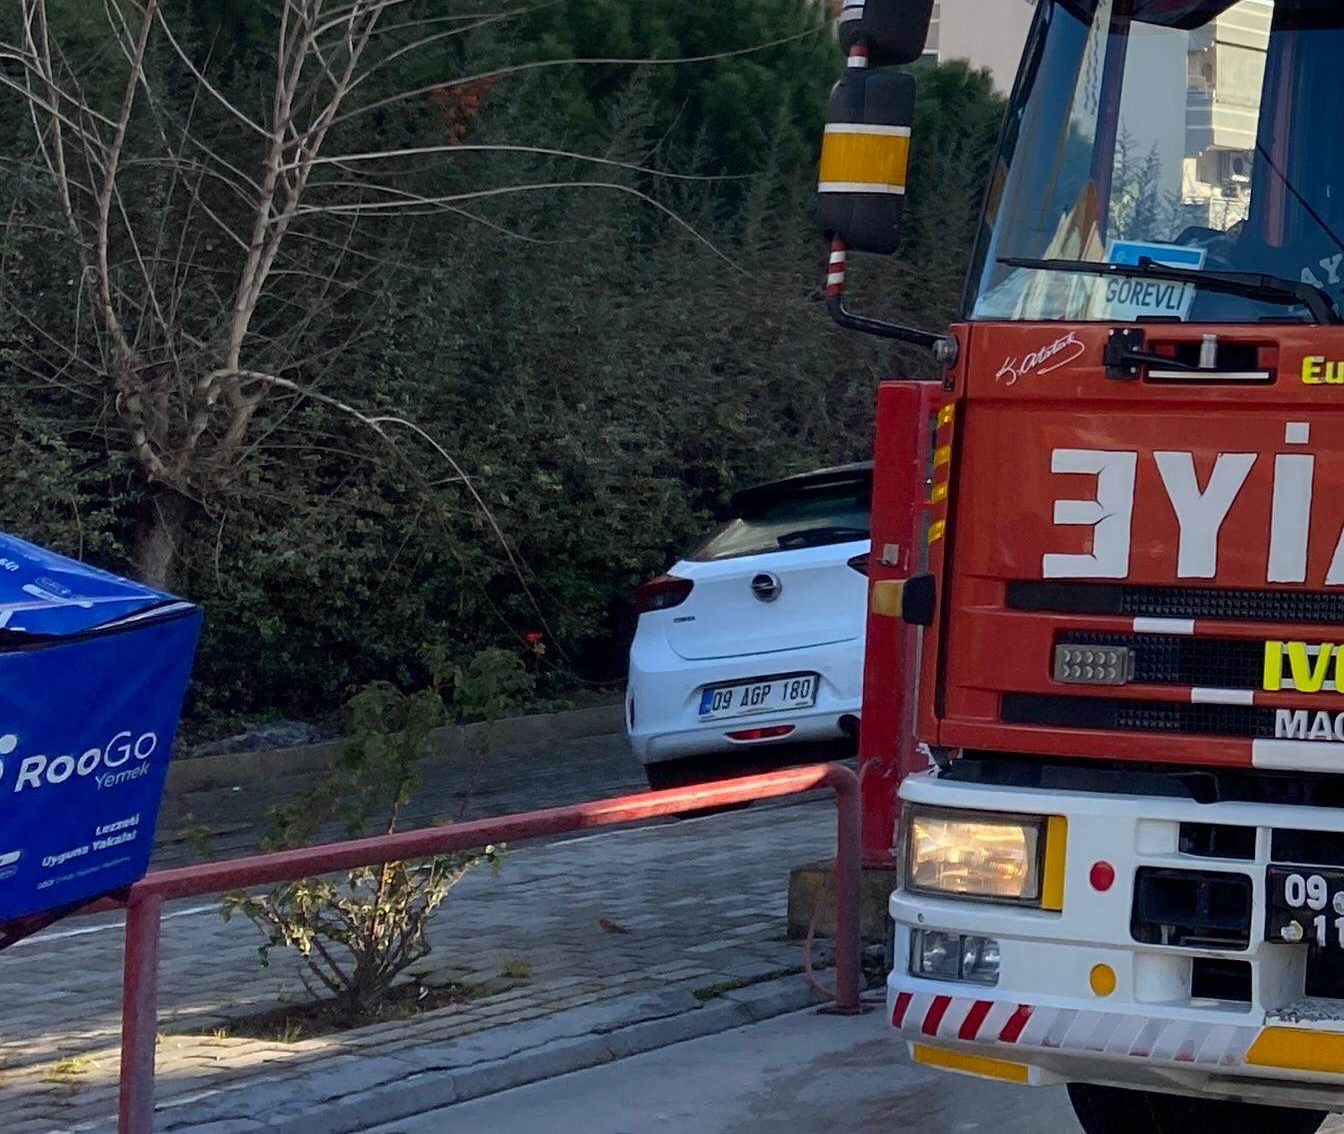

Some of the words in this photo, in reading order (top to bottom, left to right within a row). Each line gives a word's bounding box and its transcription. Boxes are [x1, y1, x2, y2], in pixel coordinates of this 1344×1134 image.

[712, 690, 733, 711] 09
[739, 686, 771, 707] AGP
[782, 679, 811, 701] 180
[95, 761, 151, 791] Yemek
[1284, 874, 1328, 911] 09
